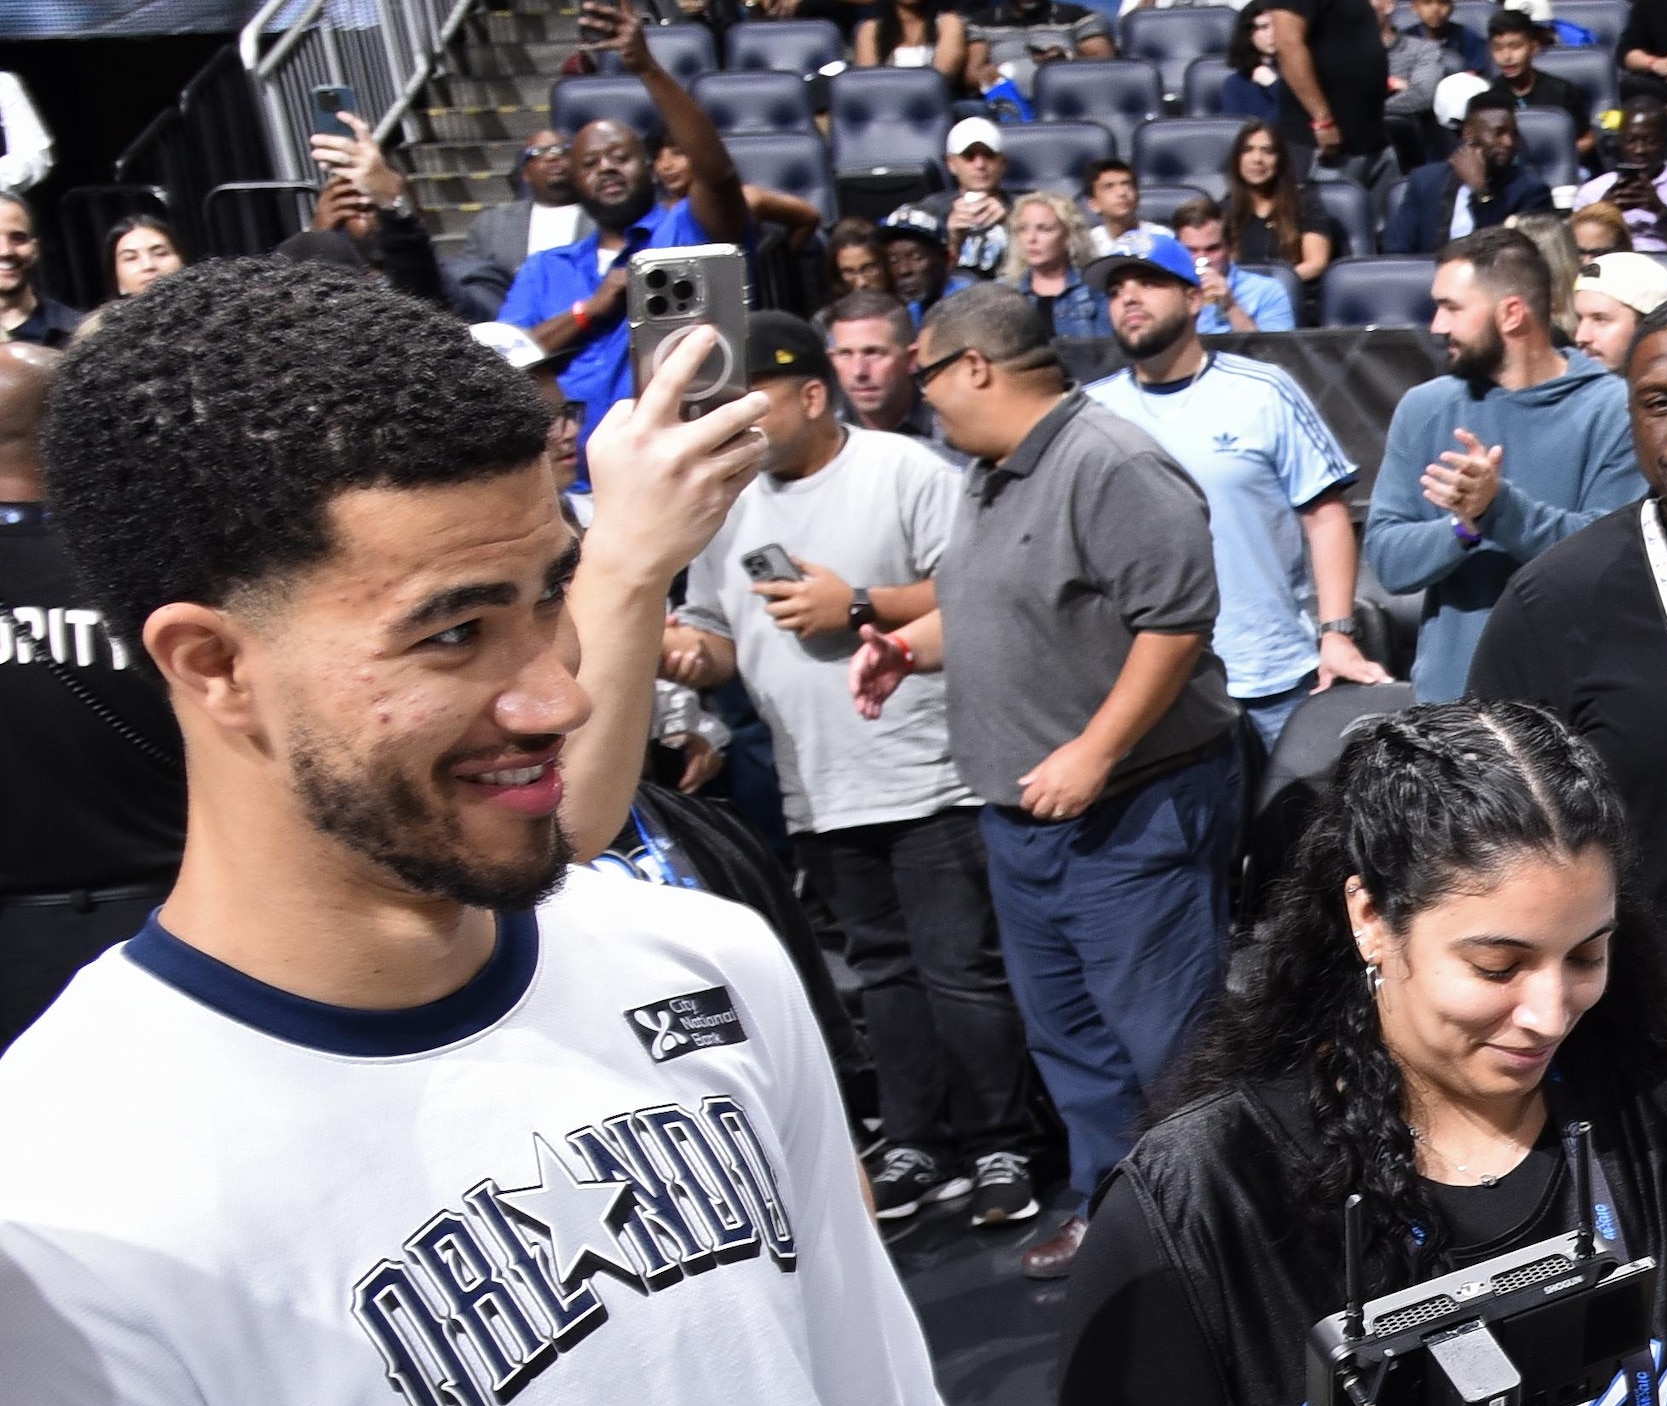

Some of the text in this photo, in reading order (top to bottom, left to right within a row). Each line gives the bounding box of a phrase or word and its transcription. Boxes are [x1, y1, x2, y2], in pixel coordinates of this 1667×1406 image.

[668, 999, 699, 1014] City
[679, 1008, 738, 1030] National
[691, 1032, 724, 1046] Bank
